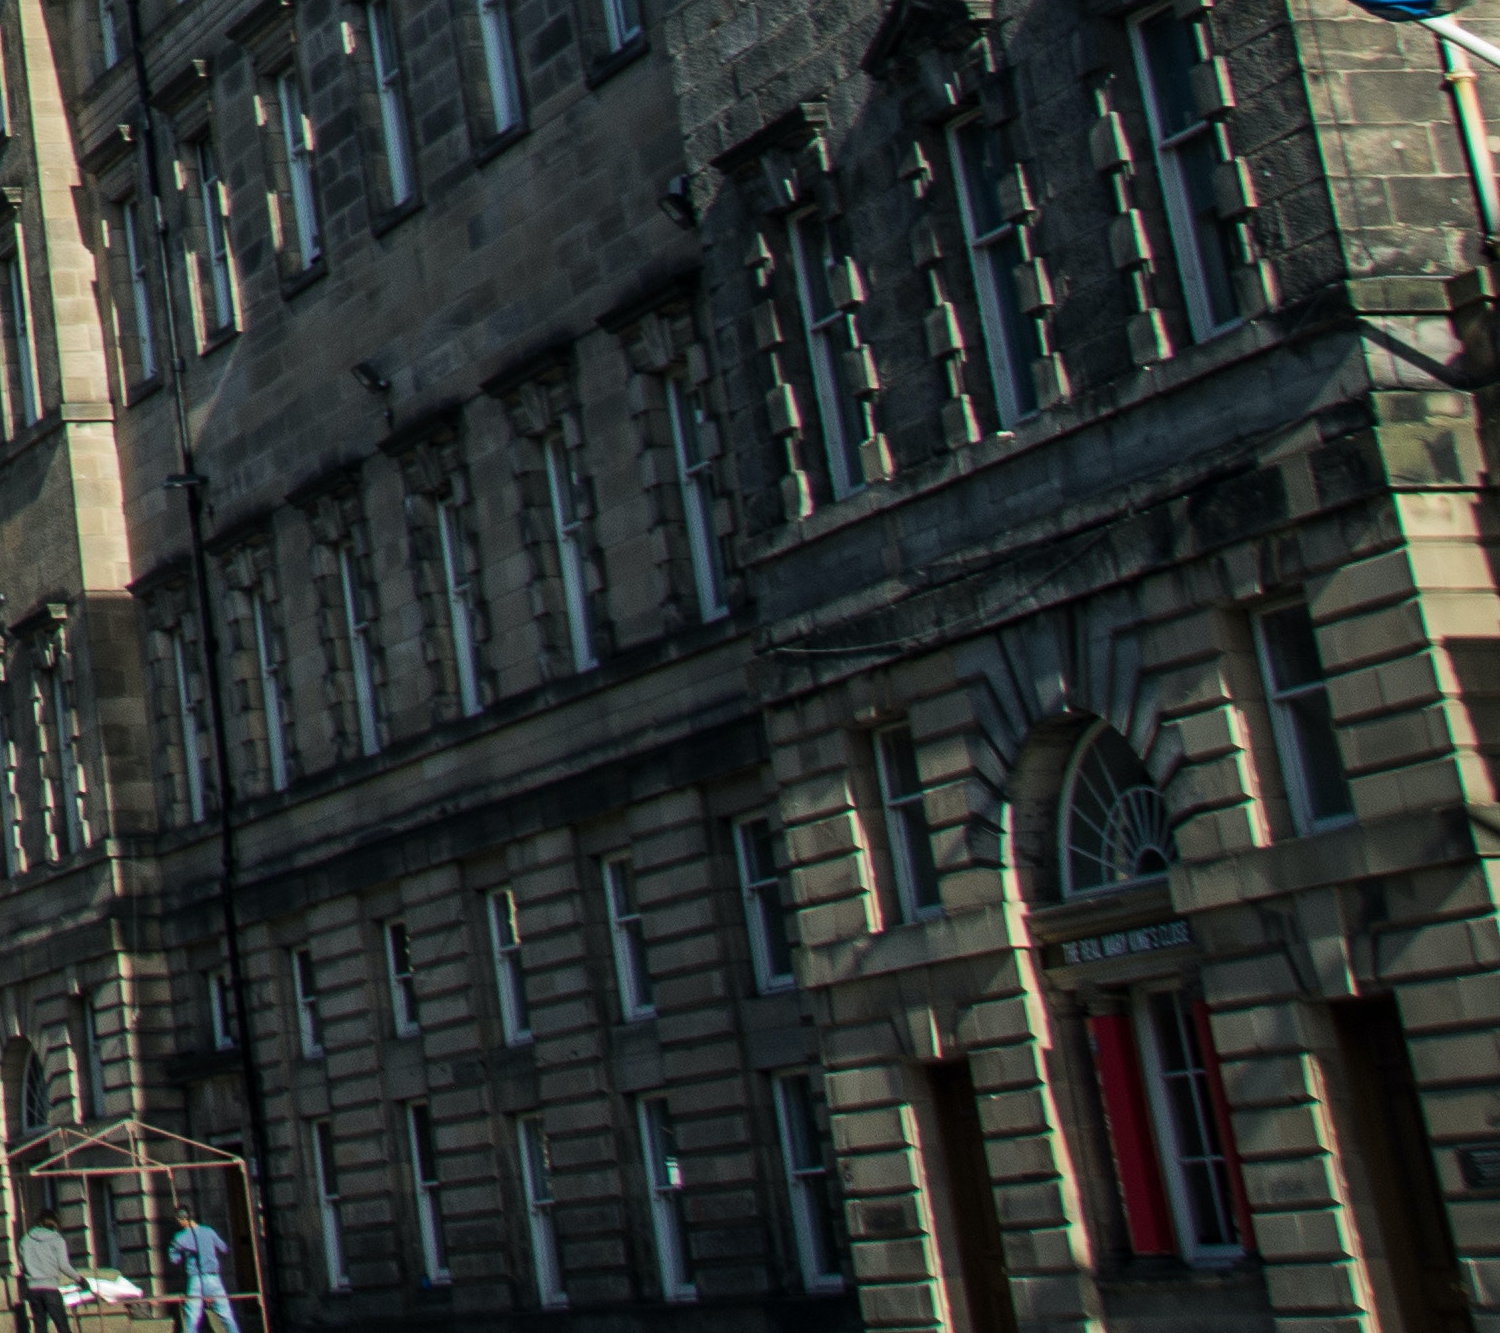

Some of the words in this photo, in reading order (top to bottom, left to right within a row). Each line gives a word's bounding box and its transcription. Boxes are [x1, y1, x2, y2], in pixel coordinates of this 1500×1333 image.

[1061, 941, 1081, 964] THE
[1079, 938, 1103, 961] REAL
[1100, 933, 1129, 958] MARY
[1158, 920, 1191, 947] CLOSE
